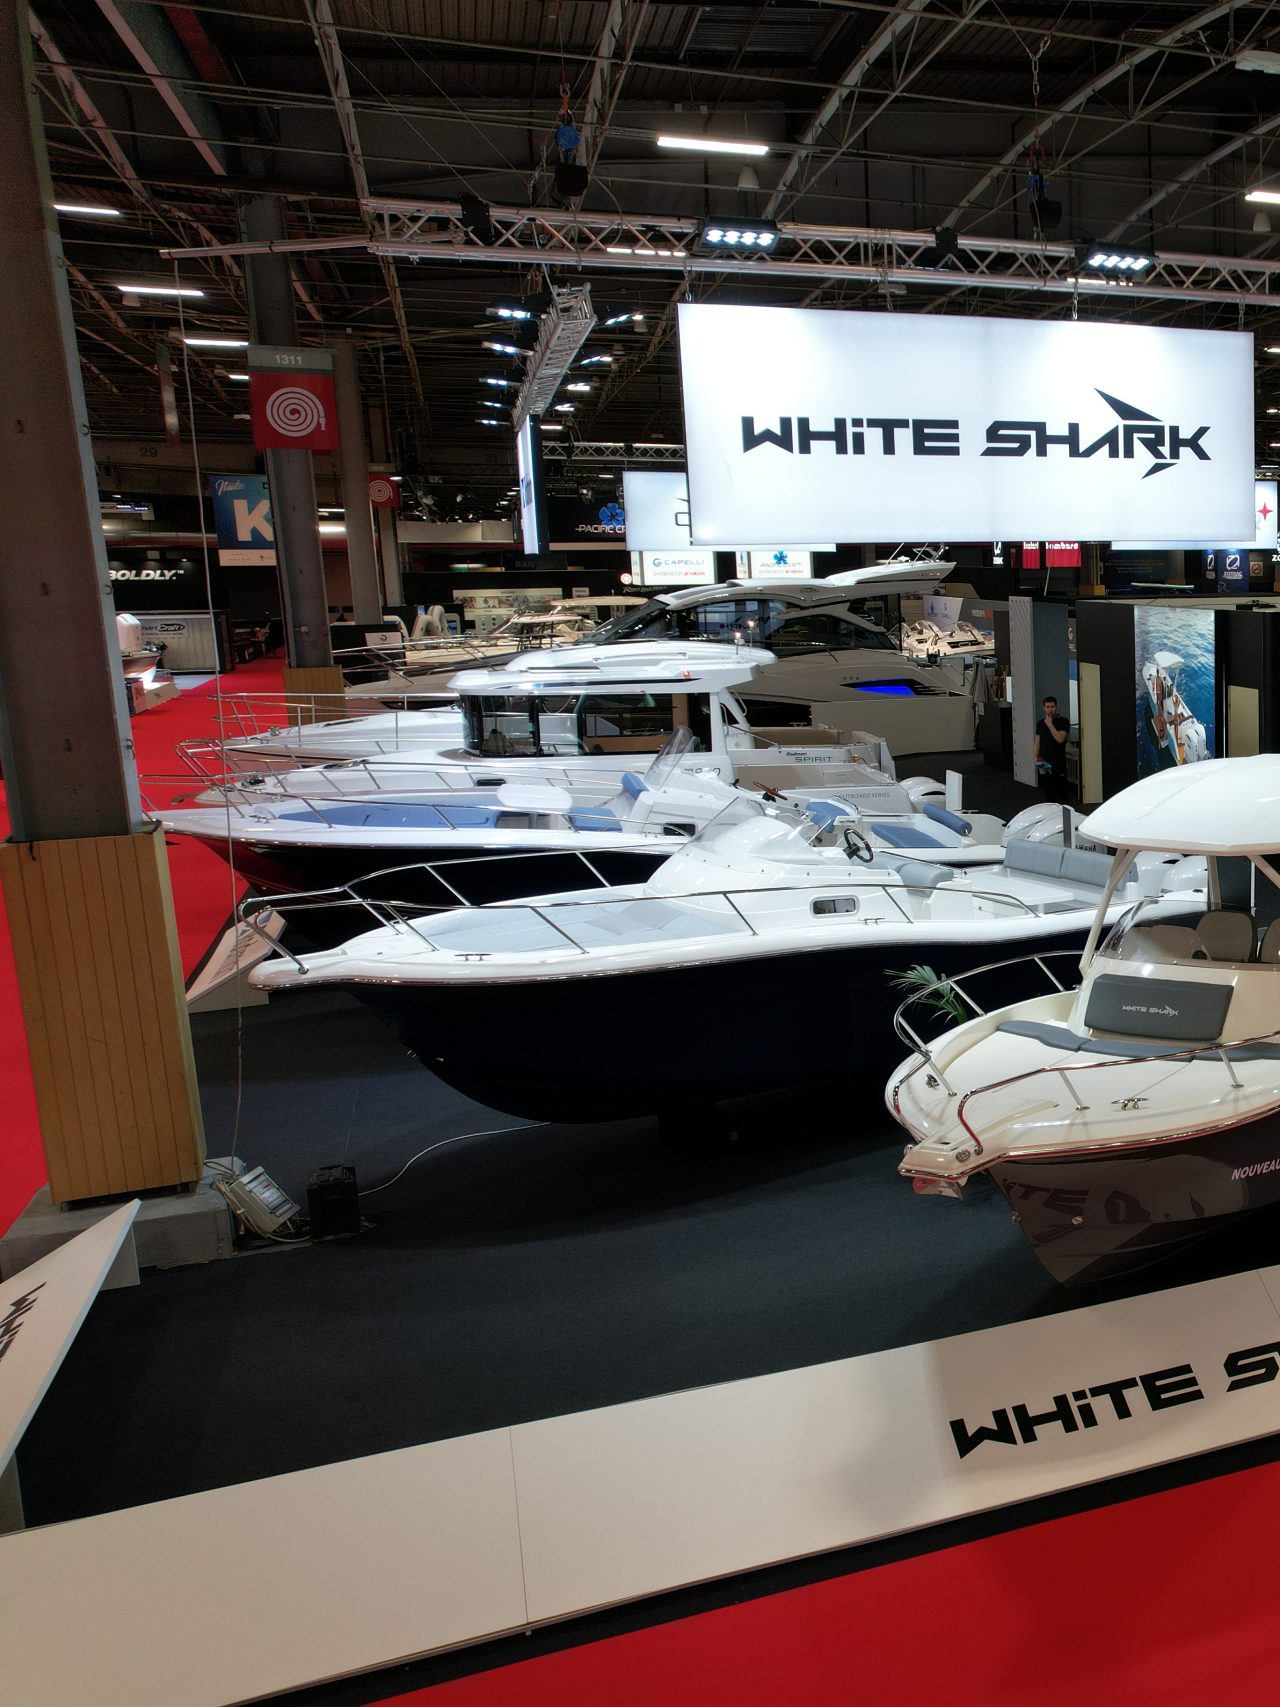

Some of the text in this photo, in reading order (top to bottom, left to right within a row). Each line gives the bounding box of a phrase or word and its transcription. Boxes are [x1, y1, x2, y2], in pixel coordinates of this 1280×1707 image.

[275, 354, 302, 365] 1311
[979, 419, 1212, 479] SHARK
[233, 499, 274, 542] K
[664, 559, 705, 567] CAPELLI
